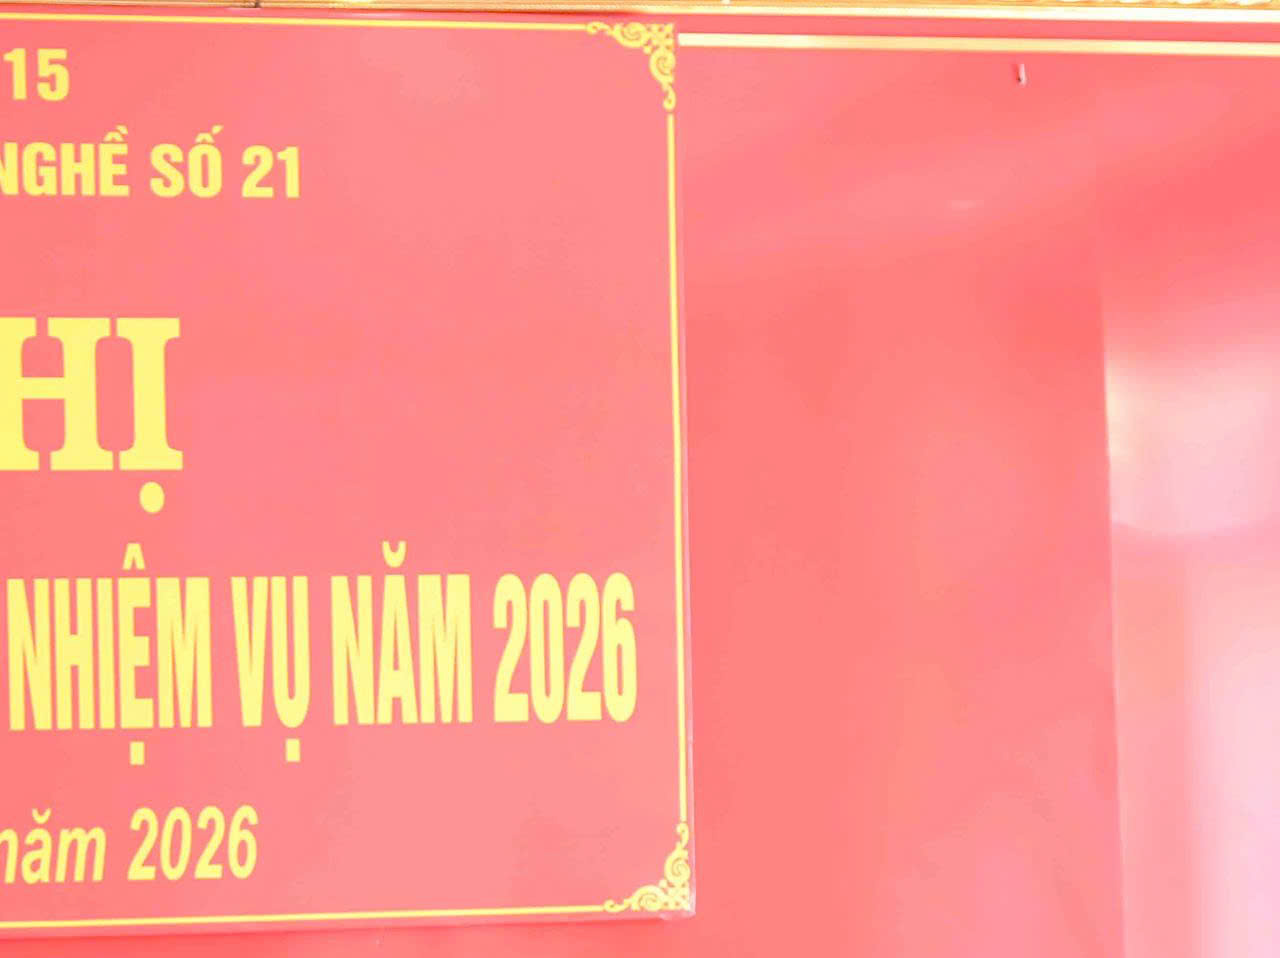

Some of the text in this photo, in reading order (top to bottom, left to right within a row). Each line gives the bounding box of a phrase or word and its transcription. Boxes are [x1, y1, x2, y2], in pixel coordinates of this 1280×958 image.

[4, 48, 69, 101] 15
[150, 125, 223, 198] SỐ
[242, 145, 299, 198] 21
[7, 544, 213, 765] NHIỆM
[231, 576, 310, 762] VỤ
[331, 541, 473, 726] NĂM
[492, 572, 637, 724] 2026
[128, 805, 258, 880] 2026
